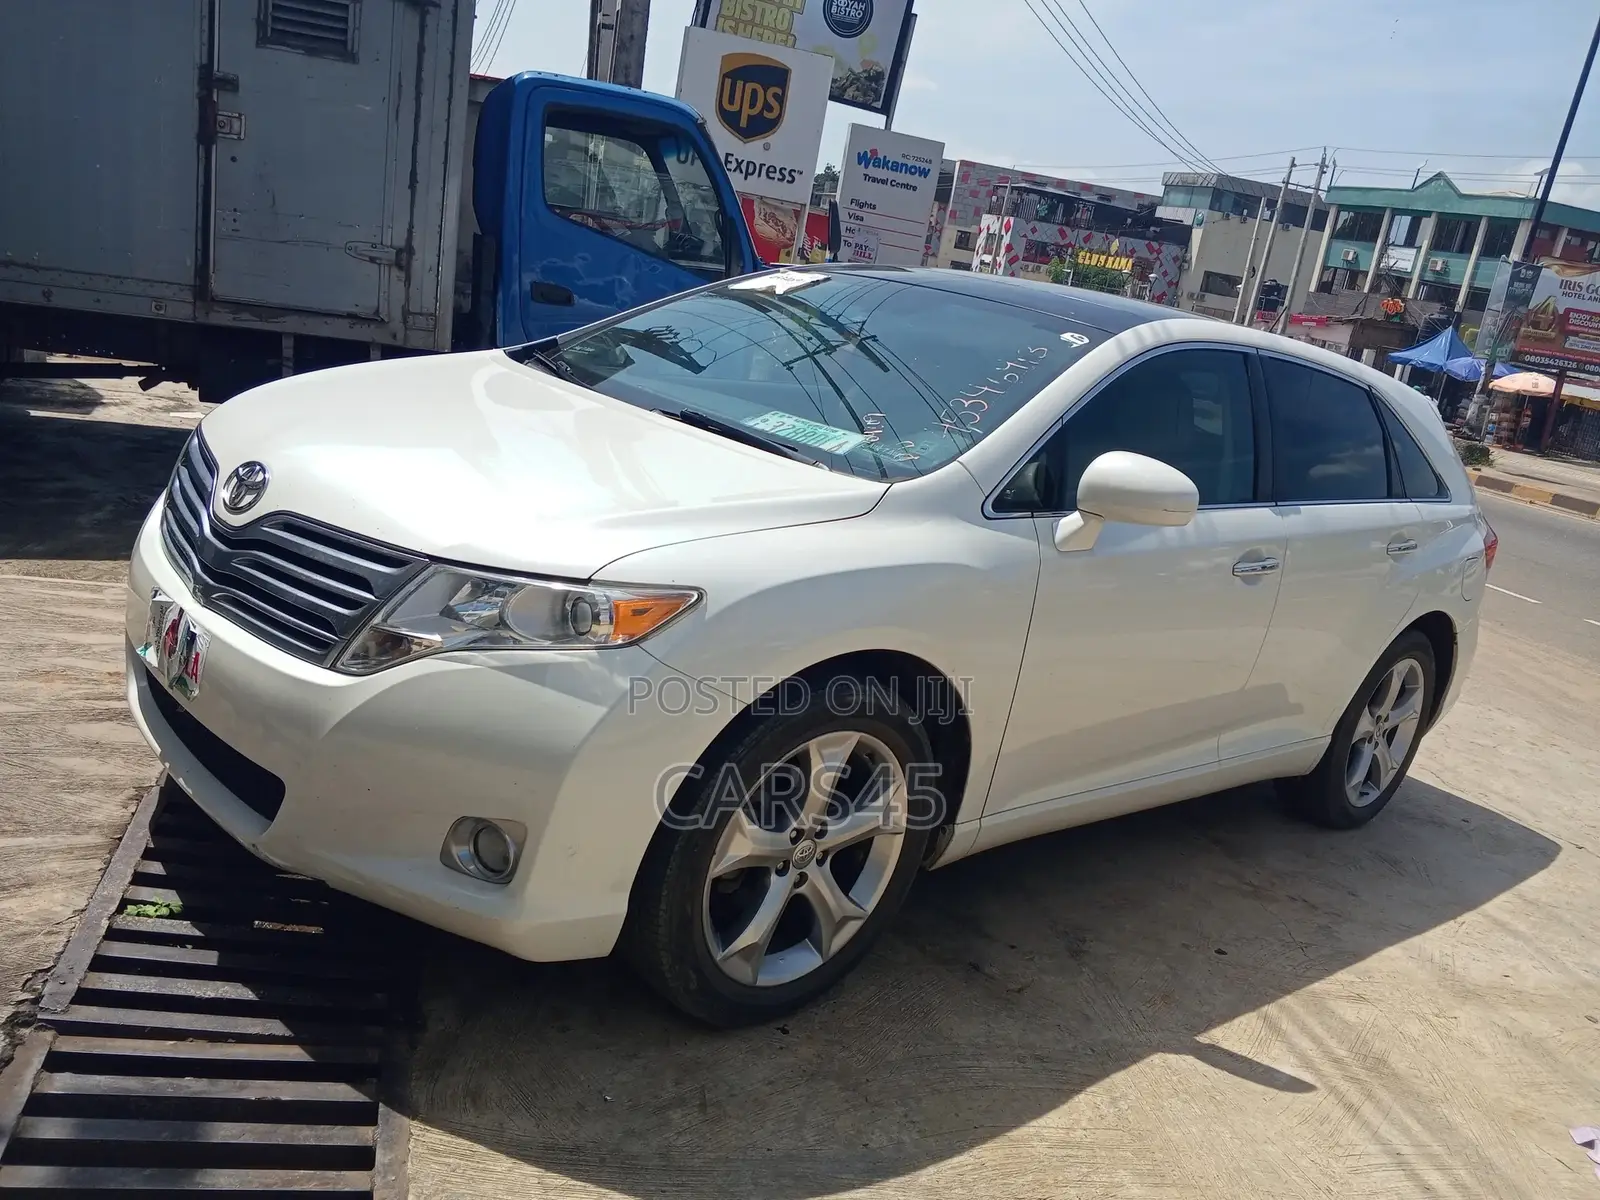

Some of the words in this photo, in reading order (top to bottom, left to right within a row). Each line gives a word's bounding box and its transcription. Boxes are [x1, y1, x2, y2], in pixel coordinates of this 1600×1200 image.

[720, 0, 792, 31] BISTRO
[831, 5, 863, 18] BISTRO
[857, 149, 931, 179] Wakanow
[863, 173, 888, 186] Travel
[889, 179, 918, 192] Centre
[850, 198, 877, 211] Flights
[847, 212, 864, 222] Visa
[1559, 279, 1583, 293] IRIS
[1562, 290, 1586, 300] HOTEL
[1569, 311, 1591, 321] ENJOY
